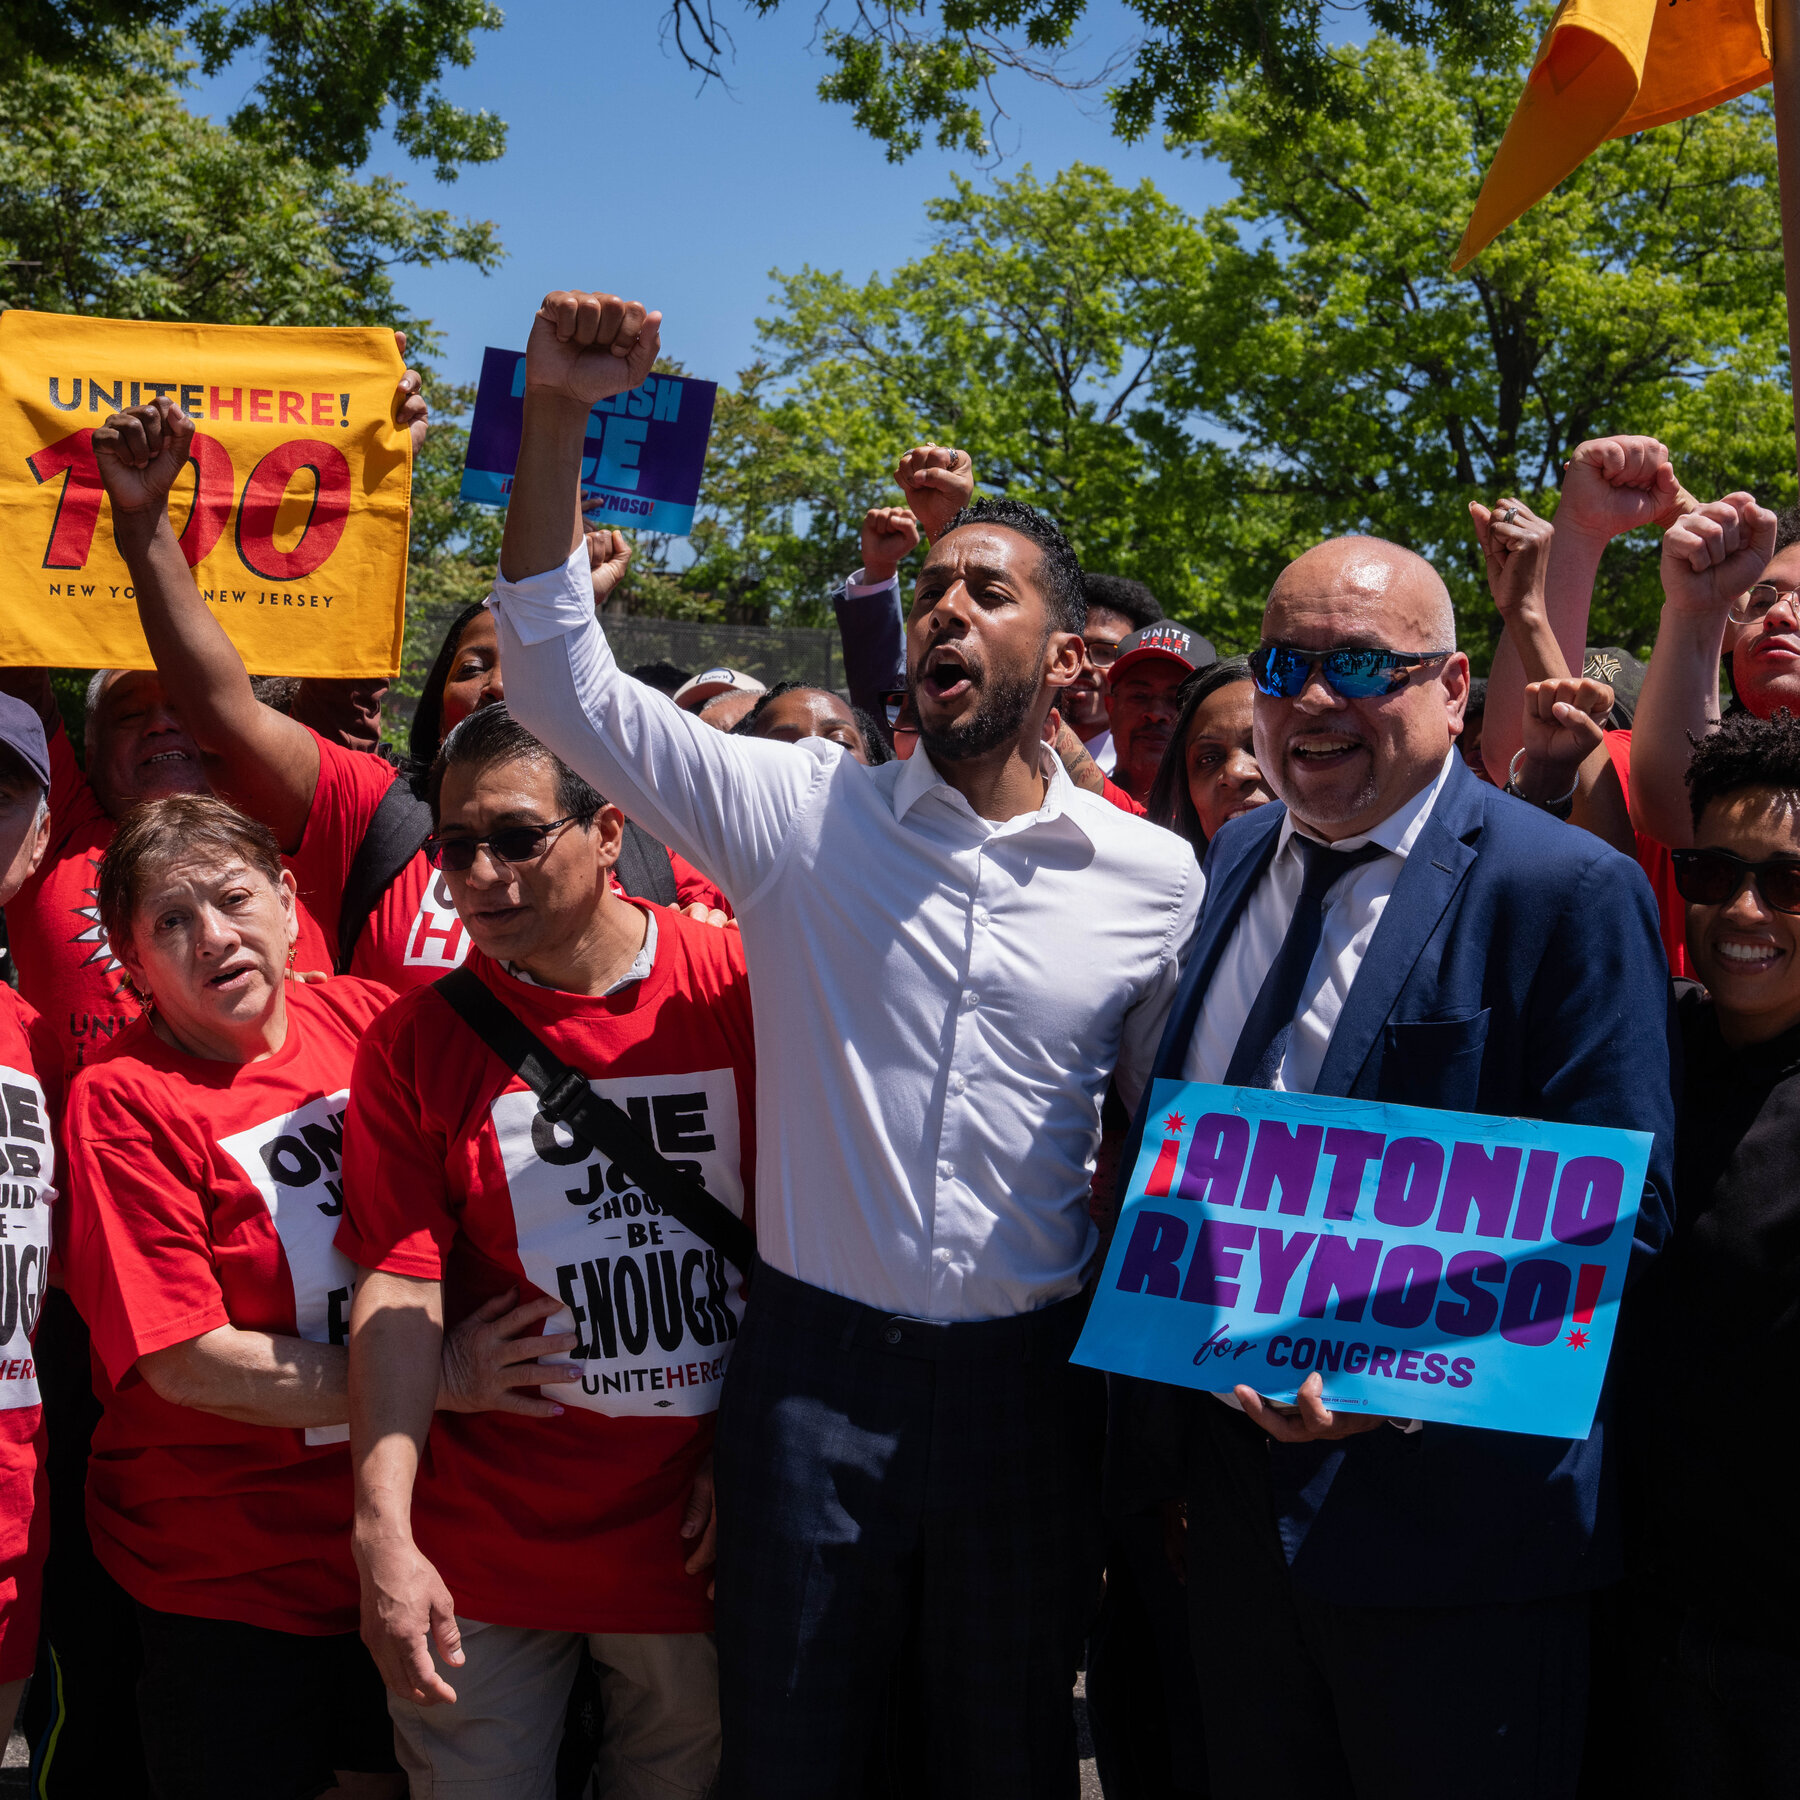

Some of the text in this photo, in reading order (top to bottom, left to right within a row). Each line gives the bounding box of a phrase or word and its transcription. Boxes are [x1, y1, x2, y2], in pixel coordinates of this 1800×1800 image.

[49, 583, 96, 598] NEW
[204, 589, 247, 604] NEW
[258, 591, 335, 609] JERSEY
[1141, 627, 1191, 641] UNITE
[1144, 1110, 1625, 1247] ¡ANTONIO
[627, 1221, 664, 1248] BE
[556, 1248, 738, 1360] ENOUGH
[1115, 1210, 1607, 1352] REYNOSO!
[1193, 1323, 1476, 1389] for CONGRESS
